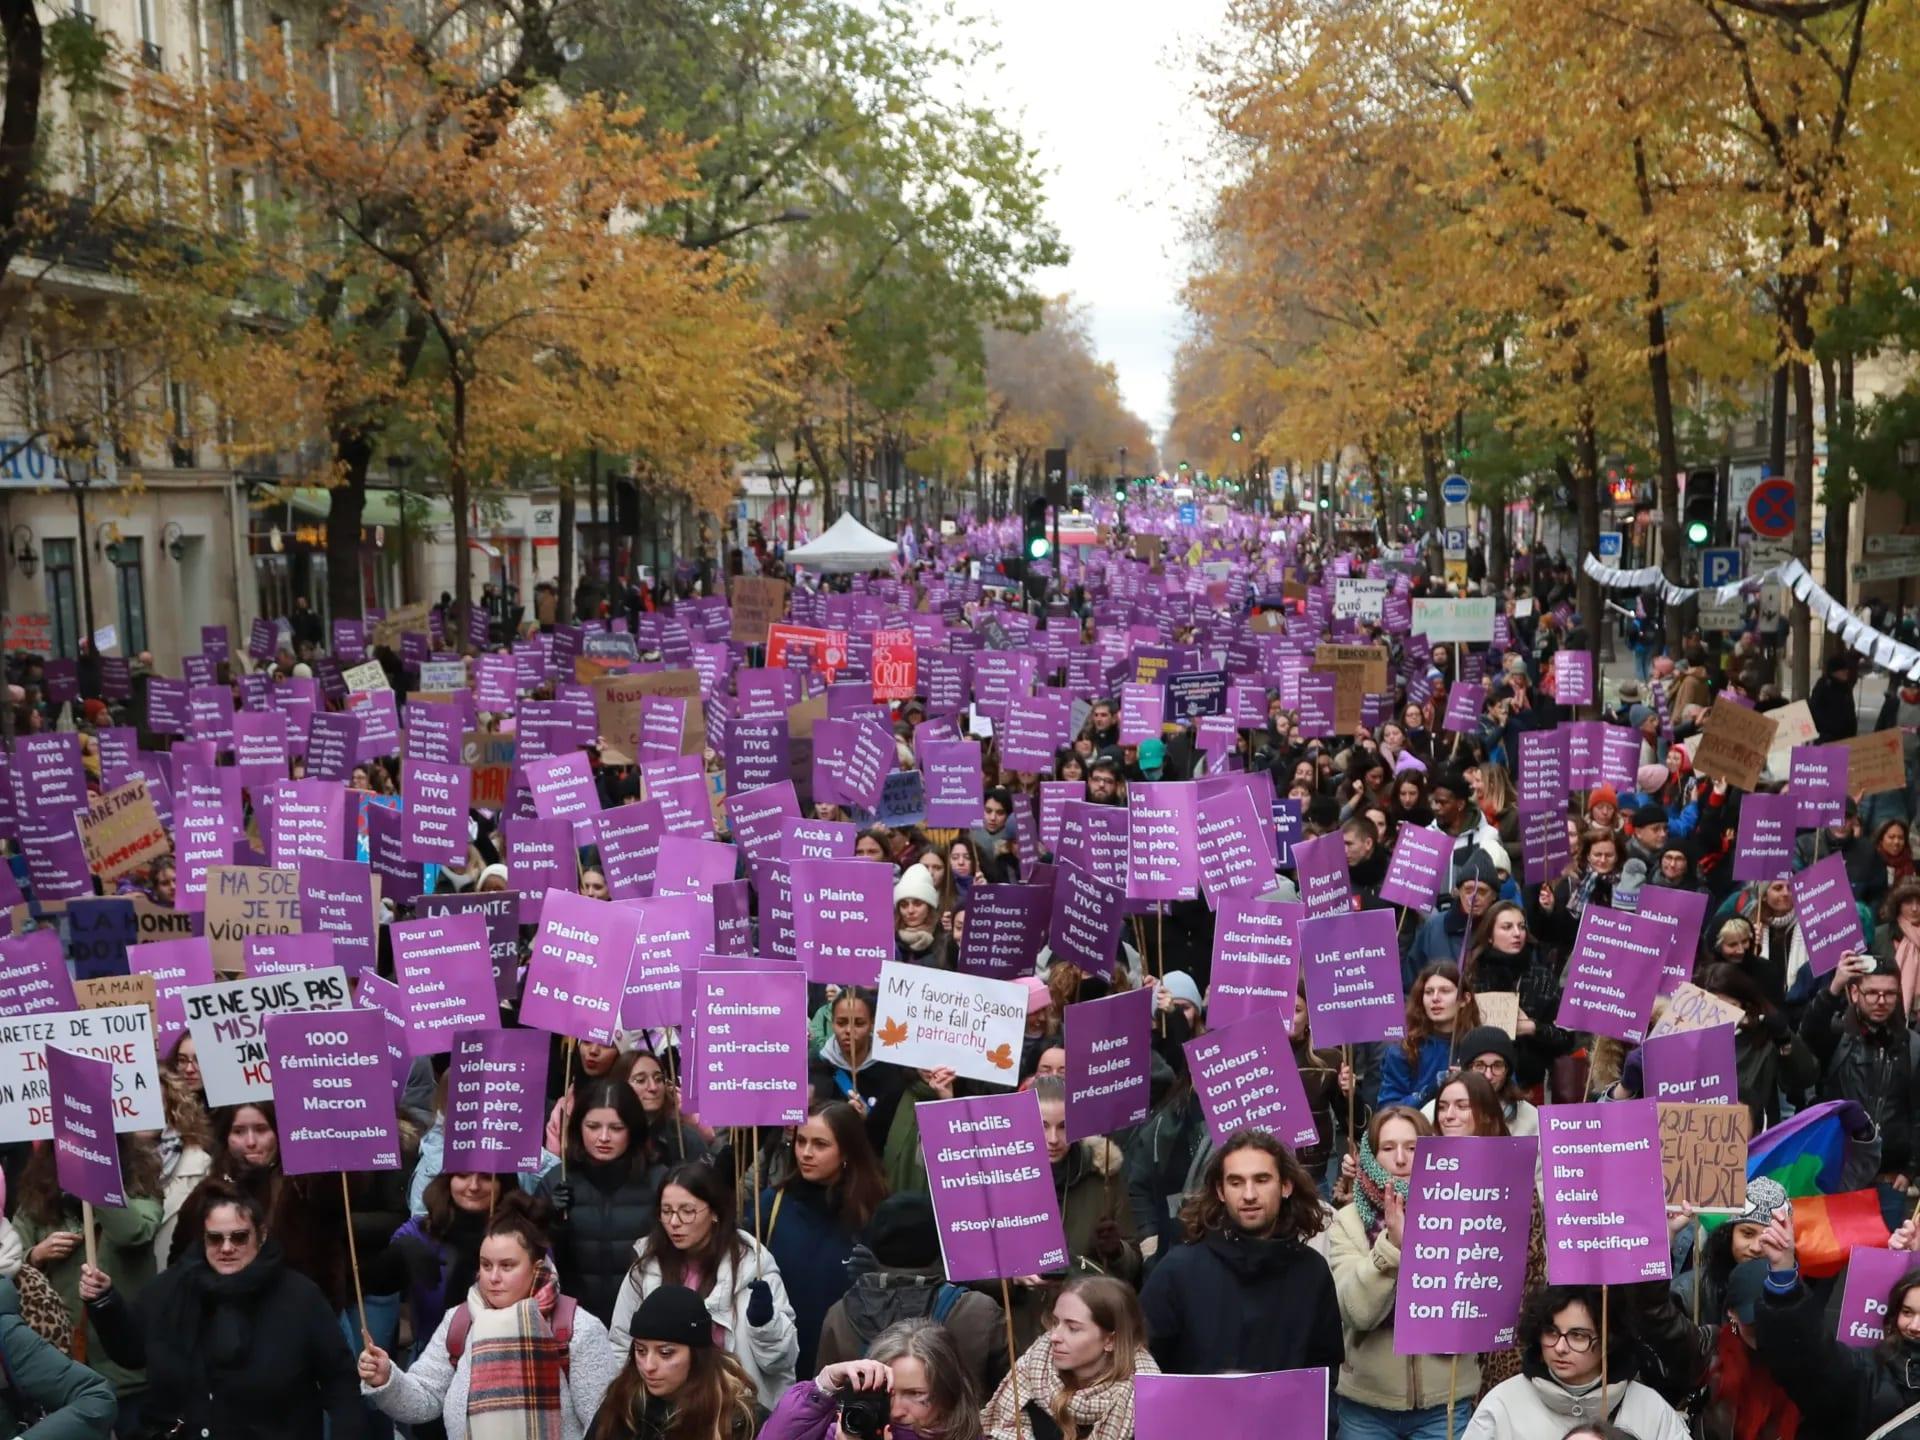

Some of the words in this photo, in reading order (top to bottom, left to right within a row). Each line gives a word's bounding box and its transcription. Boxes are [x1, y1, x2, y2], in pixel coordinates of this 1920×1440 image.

[1448, 530, 1462, 549] P
[1712, 557, 1730, 582] P
[735, 726, 768, 736] Accès
[771, 727, 778, 736] à
[28, 740, 60, 751] Accès
[63, 740, 70, 748] à
[736, 755, 778, 765] partout
[32, 767, 73, 780] partout
[548, 766, 571, 778] 1000
[744, 770, 770, 778] pour
[1795, 763, 1828, 773] Plainte
[42, 782, 67, 793] pour
[537, 776, 588, 793] féminicides
[421, 786, 448, 799] l'IVG
[1131, 792, 1145, 802] Les
[413, 804, 456, 816] partout
[552, 802, 586, 815] Macron
[1132, 807, 1172, 818] violeurs
[1805, 801, 1815, 809] te
[1817, 801, 1840, 810] crois
[420, 821, 448, 831] pour
[1756, 820, 1781, 828] Mères
[601, 824, 649, 840] féminisme
[794, 827, 831, 841] Accès
[835, 831, 843, 842] à
[1753, 833, 1781, 842] isolées
[413, 834, 454, 847] toustes
[820, 888, 864, 902] Plainte
[820, 910, 836, 919] ou
[840, 911, 868, 922] pas,
[1238, 913, 1282, 926] HandiEs
[1804, 900, 1847, 928] anti-raciste
[399, 932, 426, 941] Pour
[429, 929, 443, 937] un
[547, 921, 599, 944] Plainte
[651, 930, 690, 942] enfant
[1224, 931, 1292, 946] discriminéEs
[1811, 922, 1857, 953] anti-fasciste
[403, 941, 481, 959] consentement
[642, 948, 672, 960] n'est
[820, 944, 833, 955] Je
[837, 945, 851, 956] te
[854, 946, 886, 958] crois
[1584, 933, 1660, 960] consentement
[542, 945, 562, 957] ou
[565, 950, 597, 968] pas,
[1221, 950, 1291, 965] invisibiliséEs
[1315, 951, 1340, 963] UnE
[1344, 947, 1386, 960] enfant
[405, 967, 430, 976] libre
[641, 963, 680, 979] jamais
[1335, 965, 1366, 977] n'est
[1578, 964, 1612, 978] éclairé
[408, 981, 445, 994] éclairé
[708, 985, 724, 996] Le
[888, 977, 914, 998] MY
[921, 983, 970, 1008] favorite
[1218, 985, 1288, 997] #StopValidisme
[1333, 979, 1374, 996] jamais
[411, 997, 466, 1012] réversible
[533, 982, 549, 996] Je
[554, 988, 568, 1001] te
[573, 995, 610, 1012] crois
[1317, 994, 1395, 1011] consentantE
[708, 1003, 781, 1015] féminisme
[414, 1021, 426, 1029] et
[428, 1014, 485, 1029] spécifique
[906, 1002, 918, 1018] is
[923, 1003, 943, 1022] the
[949, 1009, 968, 1028] fall
[972, 1014, 991, 1032] of
[69, 1018, 92, 1037] DE
[102, 1013, 147, 1035] TOUT
[708, 1024, 730, 1034] est
[305, 1032, 348, 1045] 1000
[916, 1025, 987, 1054] patriarchy
[1092, 1037, 1128, 1053] Mères
[461, 1042, 483, 1053] Les
[708, 1041, 789, 1053] anti-raciste
[1195, 1045, 1220, 1061] Les
[280, 1052, 378, 1069] féminicides
[460, 1059, 516, 1072] violeurs
[709, 1061, 723, 1071] et
[1088, 1058, 1130, 1075] isolées
[1201, 1050, 1259, 1080] violeurs
[313, 1078, 352, 1088] sous
[458, 1082, 480, 1092] ton
[485, 1081, 524, 1094] pote,
[709, 1078, 797, 1090] anti-fasciste
[1073, 1075, 1143, 1103] précarisées
[1207, 1081, 1232, 1096] ton
[1235, 1067, 1273, 1088] pote,
[1659, 1080, 1696, 1096] Pour
[1701, 1075, 1719, 1087] un
[64, 1094, 92, 1114] Mères
[303, 1097, 366, 1110] Macron
[456, 1101, 479, 1112] ton
[483, 1099, 522, 1113] père,
[1213, 1099, 1237, 1115] ton
[1241, 1085, 1279, 1106] père,
[455, 1121, 477, 1131] ton
[482, 1117, 522, 1132] frère,
[949, 1116, 1011, 1133] HandiEs
[1218, 1117, 1243, 1132] ton
[1246, 1102, 1286, 1121] frère,
[1551, 1119, 1582, 1130] Pour
[1586, 1120, 1601, 1129] un
[65, 1117, 97, 1138] isolées
[290, 1127, 387, 1141] #ÉtatCoupable
[58, 1139, 112, 1165] précarisées
[938, 1140, 1034, 1162] discriminéEs
[1552, 1138, 1649, 1154] consentement
[1425, 1153, 1459, 1171] Les
[941, 1167, 1040, 1189] invisibiliséEs
[1554, 1165, 1584, 1178] libre
[1423, 1182, 1499, 1201] violeurs
[1556, 1189, 1598, 1202] éclairé
[951, 1213, 1048, 1232] #StopValidisme
[1418, 1214, 1452, 1230] ton
[1460, 1215, 1506, 1235] pote,
[1557, 1212, 1624, 1225] réversible
[1559, 1238, 1573, 1249] et
[1577, 1236, 1649, 1252] spécifique
[1415, 1244, 1449, 1259] ton
[1457, 1243, 1503, 1264] père,
[1412, 1273, 1446, 1288] ton
[1454, 1271, 1502, 1290] frère,
[1409, 1303, 1443, 1318] ton
[1451, 1301, 1487, 1318] fils...
